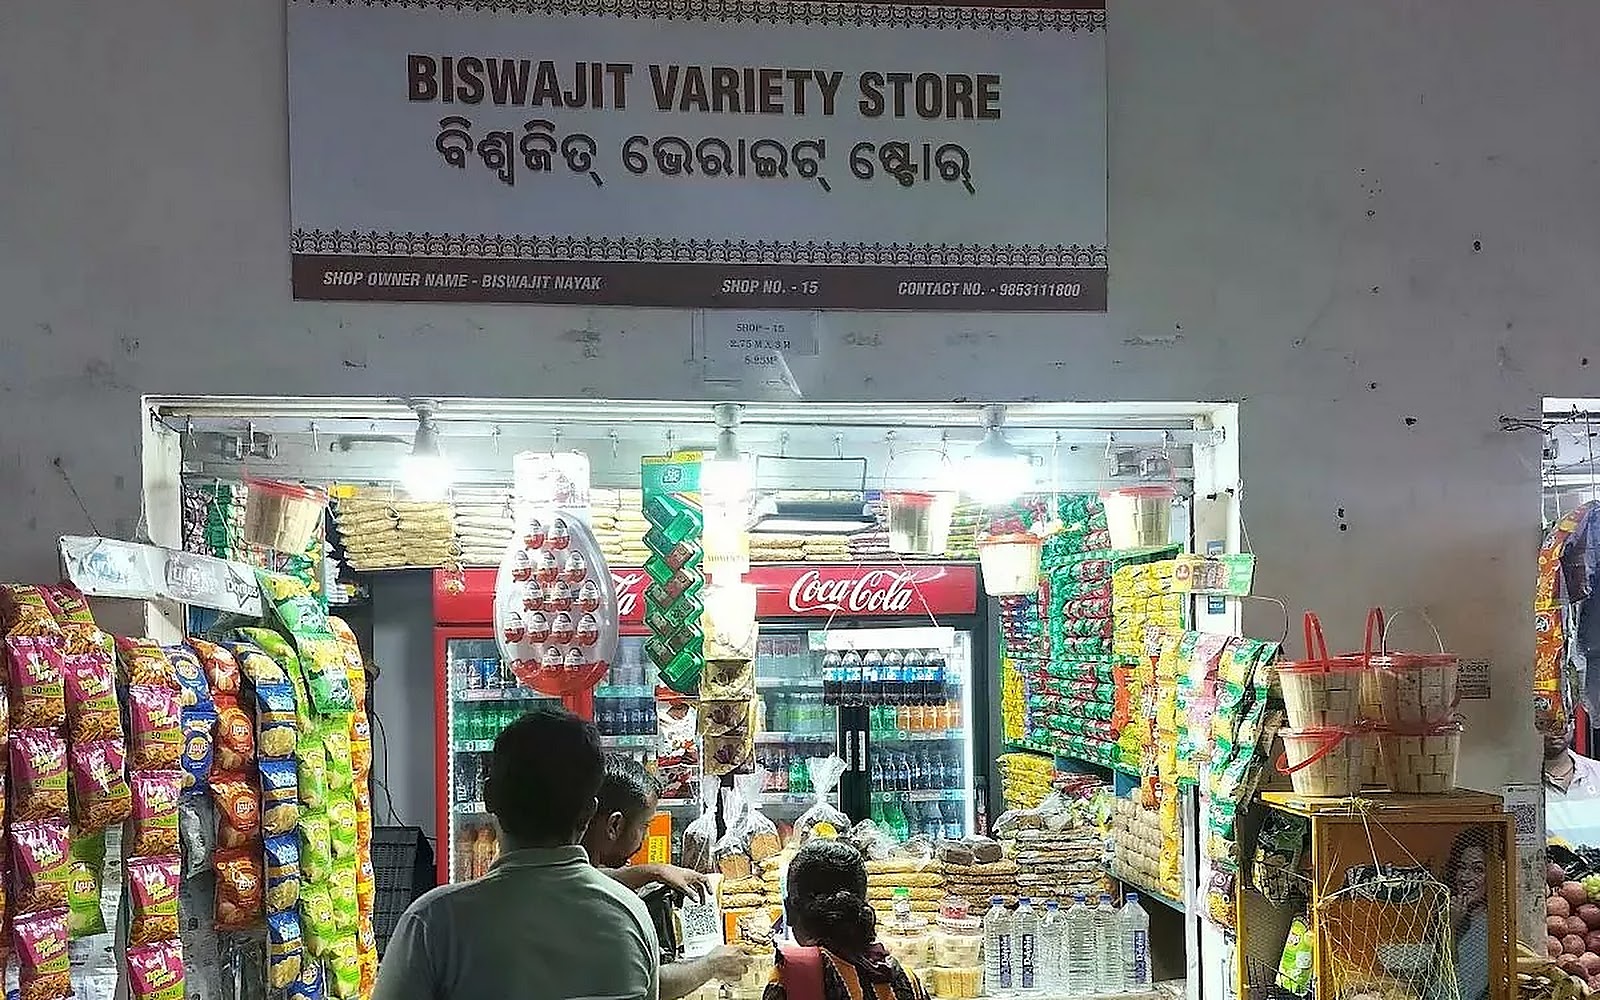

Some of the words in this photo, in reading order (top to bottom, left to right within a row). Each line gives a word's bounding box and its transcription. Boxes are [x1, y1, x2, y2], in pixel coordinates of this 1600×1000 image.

[407, 53, 633, 110] BISWAJIT
[649, 64, 843, 115] VARIETY
[858, 71, 1001, 120] STORE
[323, 271, 363, 286] SHOP
[368, 272, 420, 287] OWNER
[424, 274, 468, 288] NAME
[481, 274, 551, 290] BISWAJIT
[554, 276, 602, 290] NAYAK
[722, 279, 759, 294] SHOP
[763, 280, 788, 295] NO.
[801, 281, 819, 295] 15
[898, 281, 961, 297] CONTACT
[965, 282, 986, 297] NO.
[999, 283, 1081, 298] 9853111800
[788, 569, 912, 612] Coca-Cola
